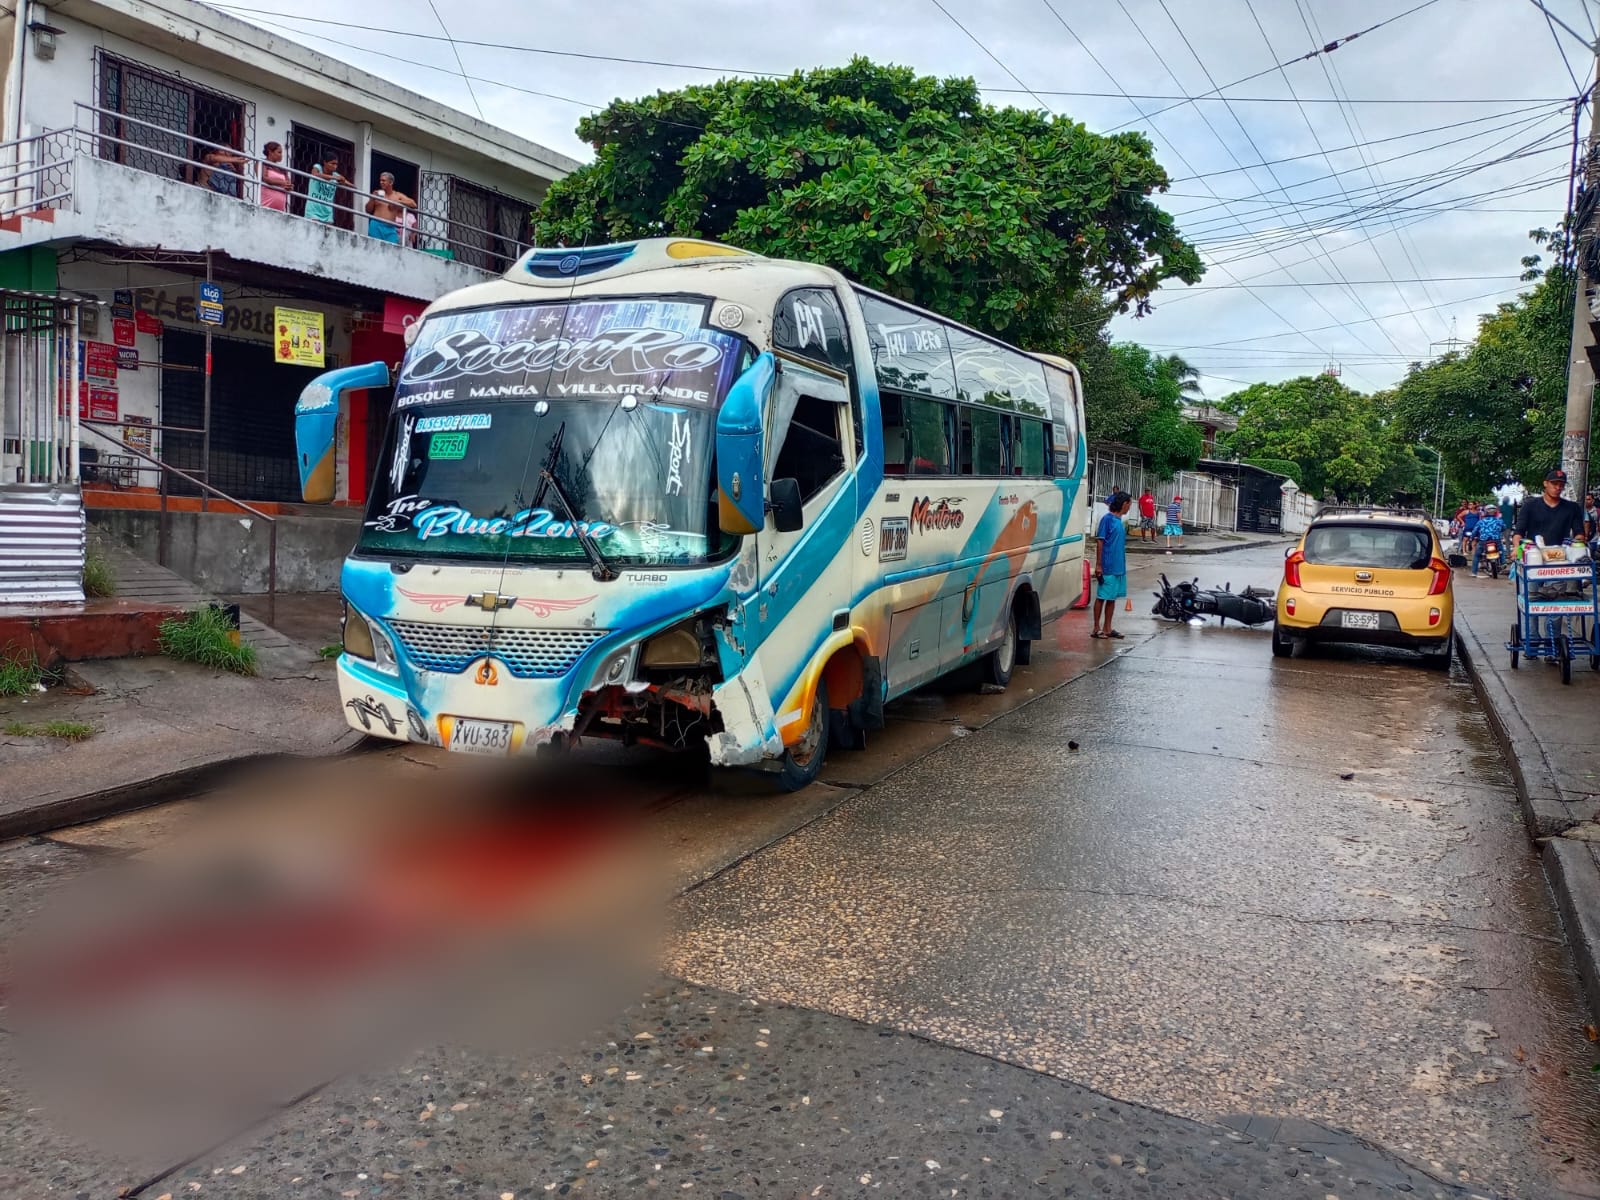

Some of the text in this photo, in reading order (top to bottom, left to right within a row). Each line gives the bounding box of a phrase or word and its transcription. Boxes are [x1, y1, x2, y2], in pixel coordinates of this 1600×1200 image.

[203, 287, 220, 302] tigo
[119, 351, 138, 359] WOM
[397, 383, 709, 408] BOSQUE MANGA VILLAGRANDE
[432, 439, 465, 453] $2750
[413, 505, 508, 540] Blue
[910, 495, 965, 537] Montero
[626, 574, 668, 582] TURBO
[1331, 586, 1394, 596] SERVICIO PUBLICO
